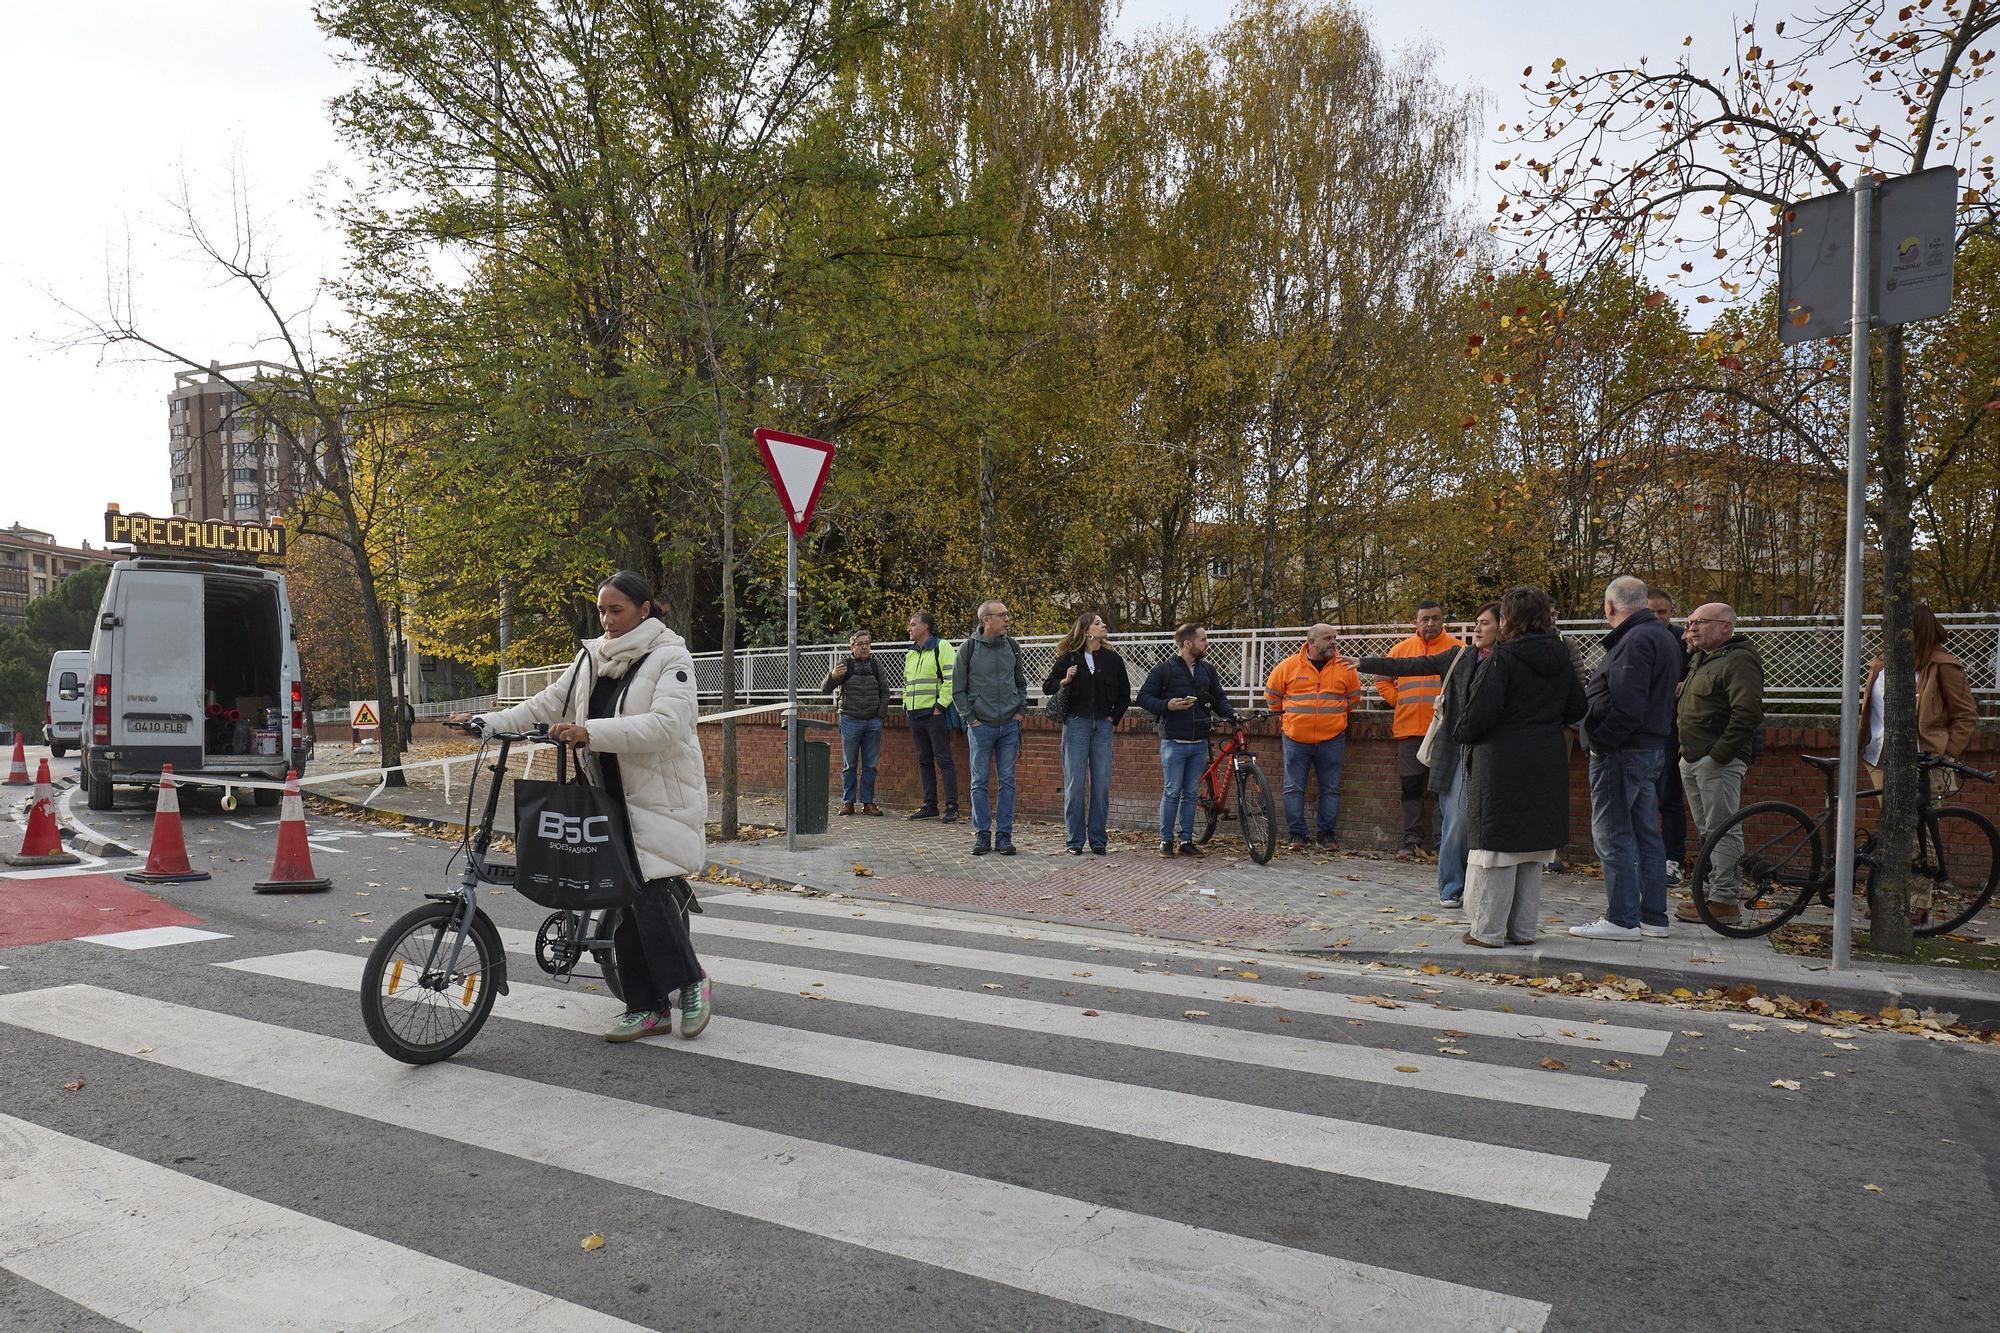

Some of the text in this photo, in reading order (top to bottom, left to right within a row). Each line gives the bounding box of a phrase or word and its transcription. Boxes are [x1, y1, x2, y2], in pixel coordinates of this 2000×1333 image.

[112, 515, 280, 554] PRECAUCION
[135, 722, 183, 733] 0410 FLB
[549, 841, 598, 854] SHOES FASHION
